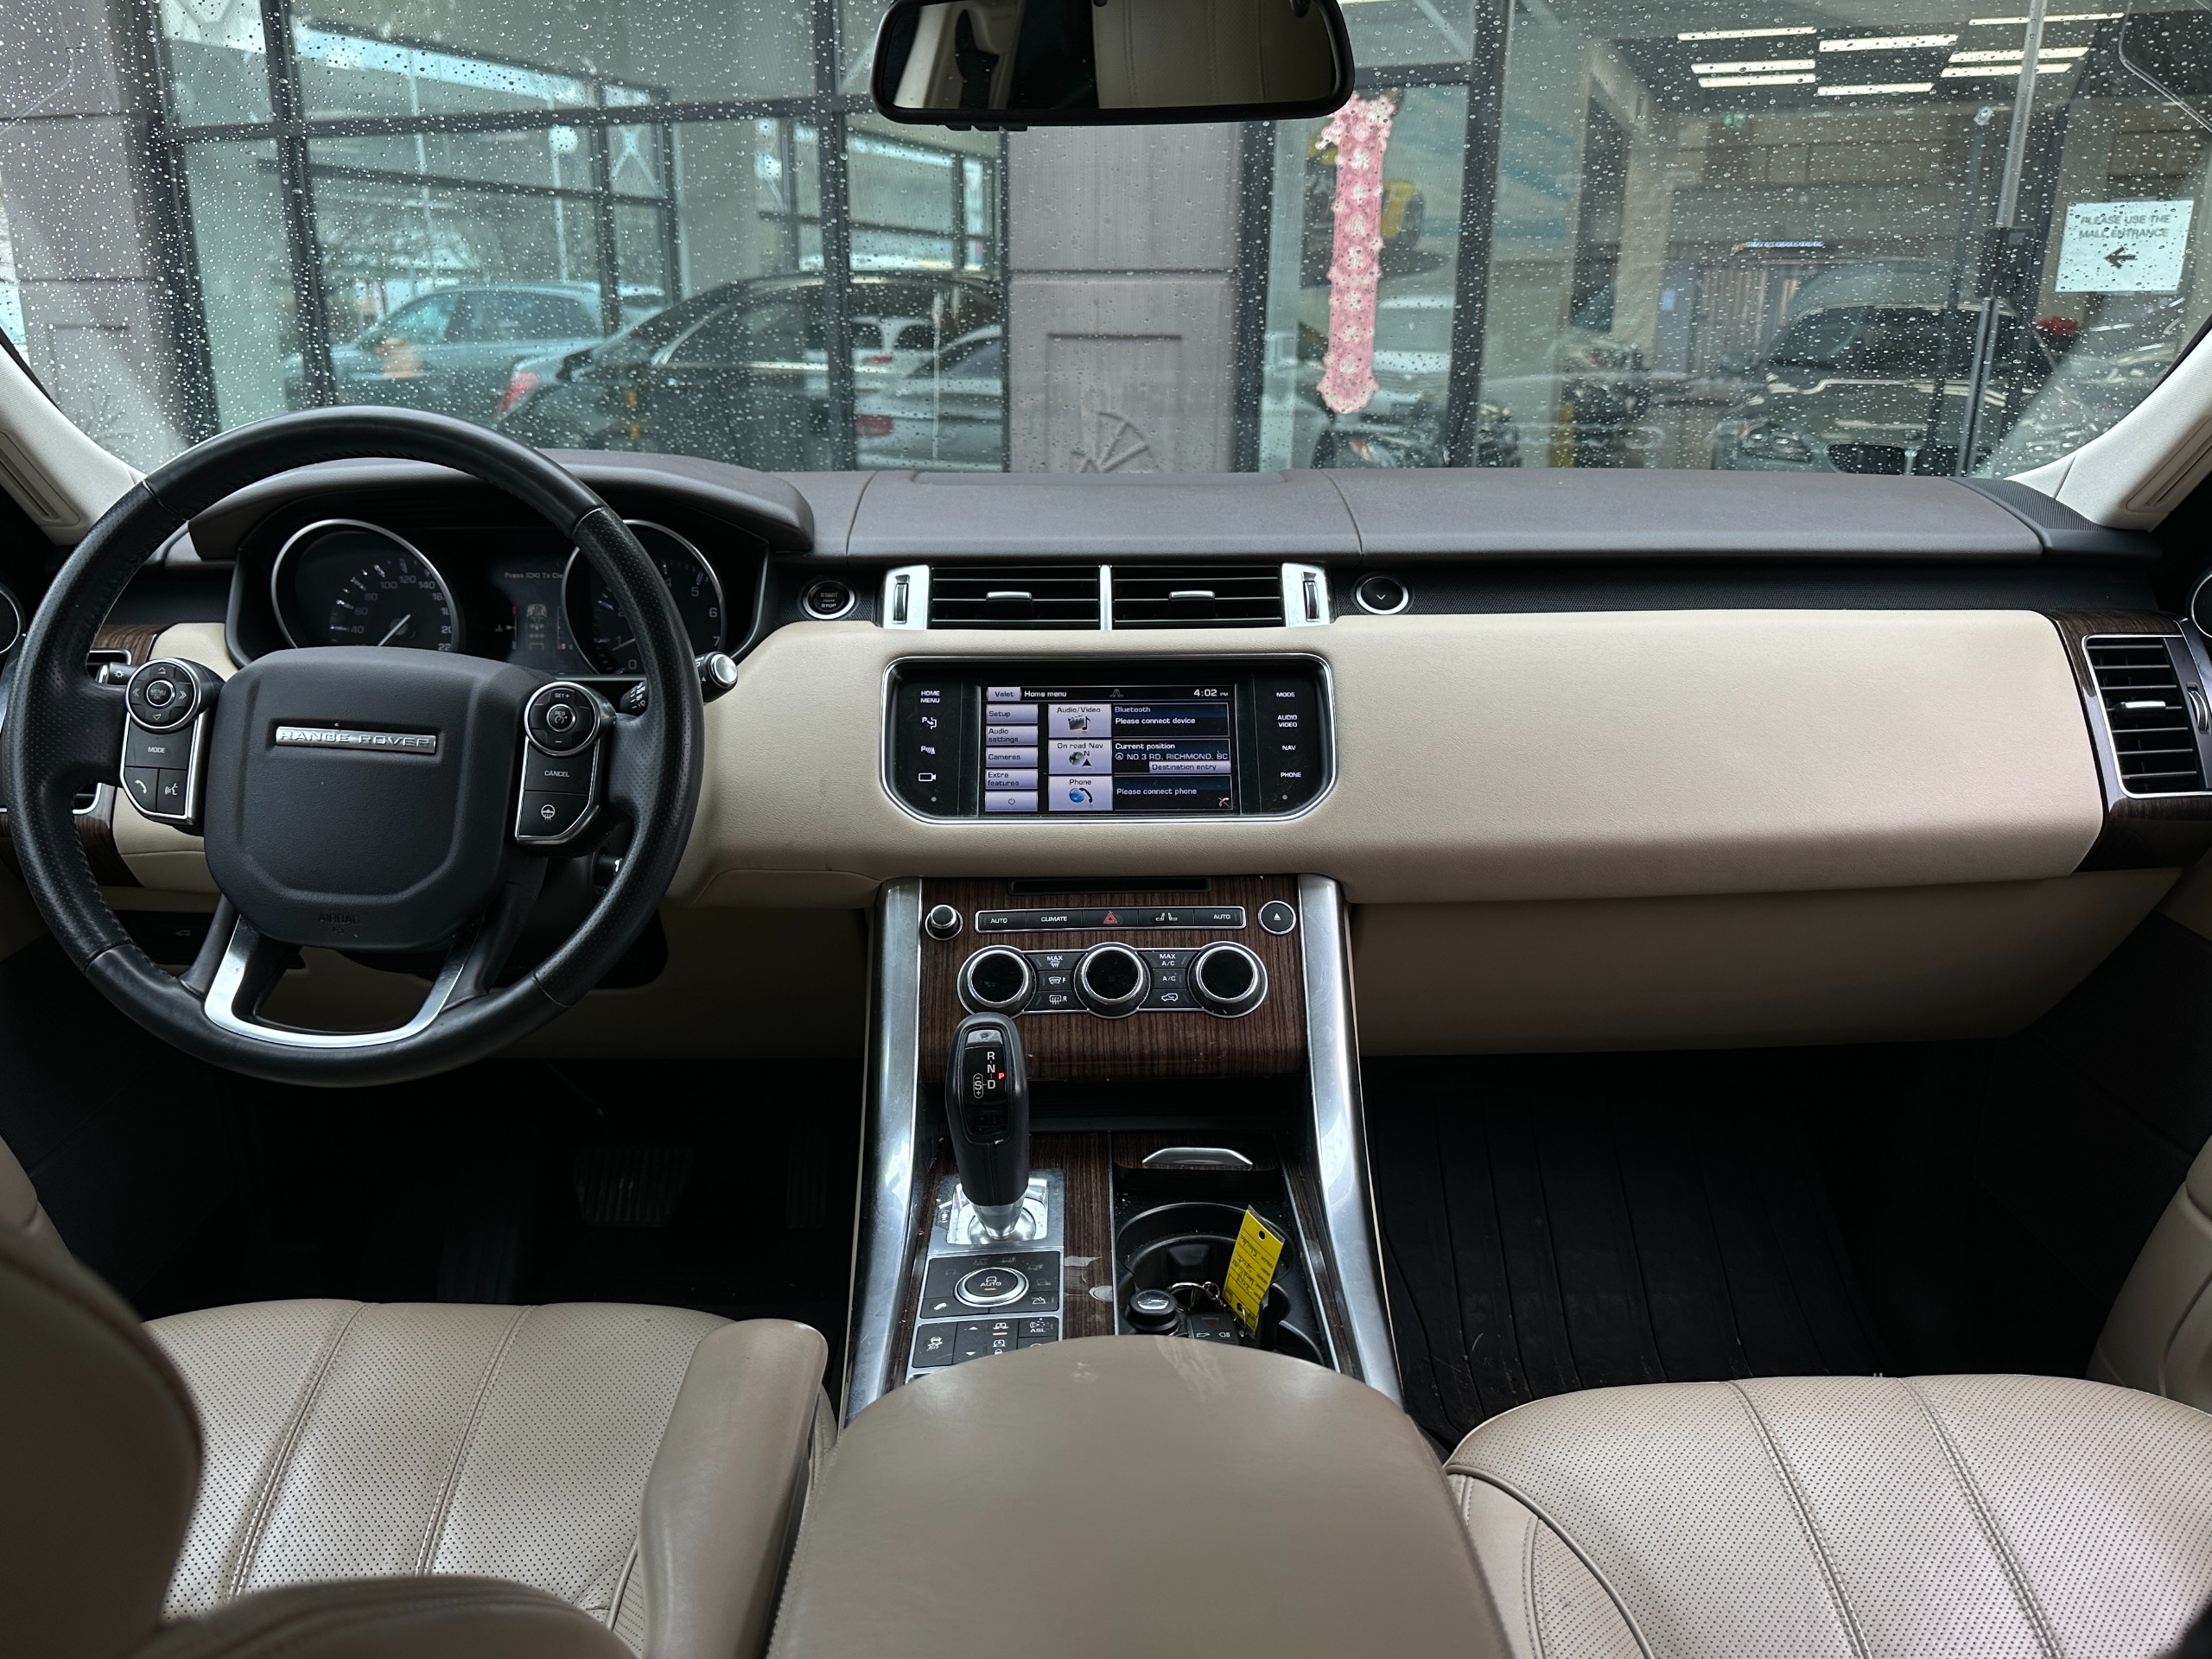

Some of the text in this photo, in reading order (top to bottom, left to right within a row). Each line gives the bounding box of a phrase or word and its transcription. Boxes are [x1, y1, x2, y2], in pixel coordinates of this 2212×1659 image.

[2081, 215, 2121, 225] PLEASE
[2125, 215, 2147, 224] USE
[2079, 228, 2169, 238] MALL ENTRANCE
[691, 587, 699, 597] 5
[709, 607, 718, 618] 6
[351, 626, 364, 634] 40
[712, 636, 720, 646] 7
[1193, 689, 1217, 697] 4:02
[280, 731, 430, 747] RANGE ROVER
[319, 912, 360, 925] AIRBAG
[987, 1052, 995, 1060] R
[987, 1065, 995, 1073] N
[975, 1081, 982, 1090] S
[988, 1079, 995, 1090] D
